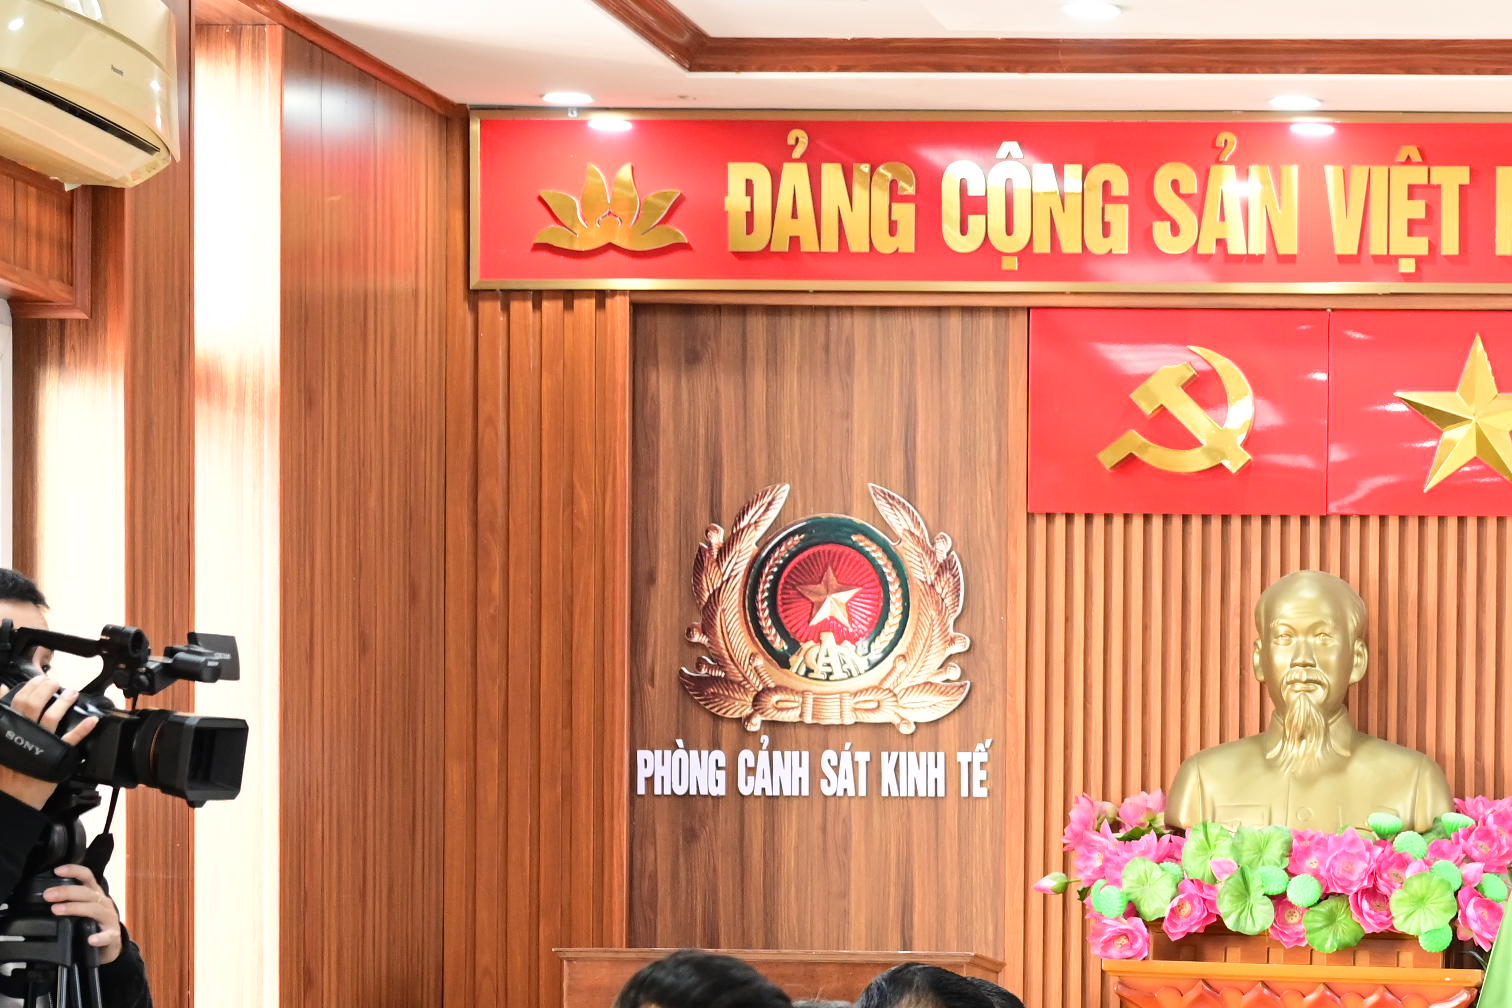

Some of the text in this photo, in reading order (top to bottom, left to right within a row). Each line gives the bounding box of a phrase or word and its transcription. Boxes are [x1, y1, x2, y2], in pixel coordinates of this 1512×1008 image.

[725, 129, 915, 253] ĐẢNG
[942, 141, 1128, 270] CỘNG
[1152, 132, 1299, 255] SẢN
[1324, 145, 1470, 272] VIỆT
[5, 730, 45, 756] SONY
[637, 735, 993, 798] PHÒNG CẢNH SÁT KINH TẾ
